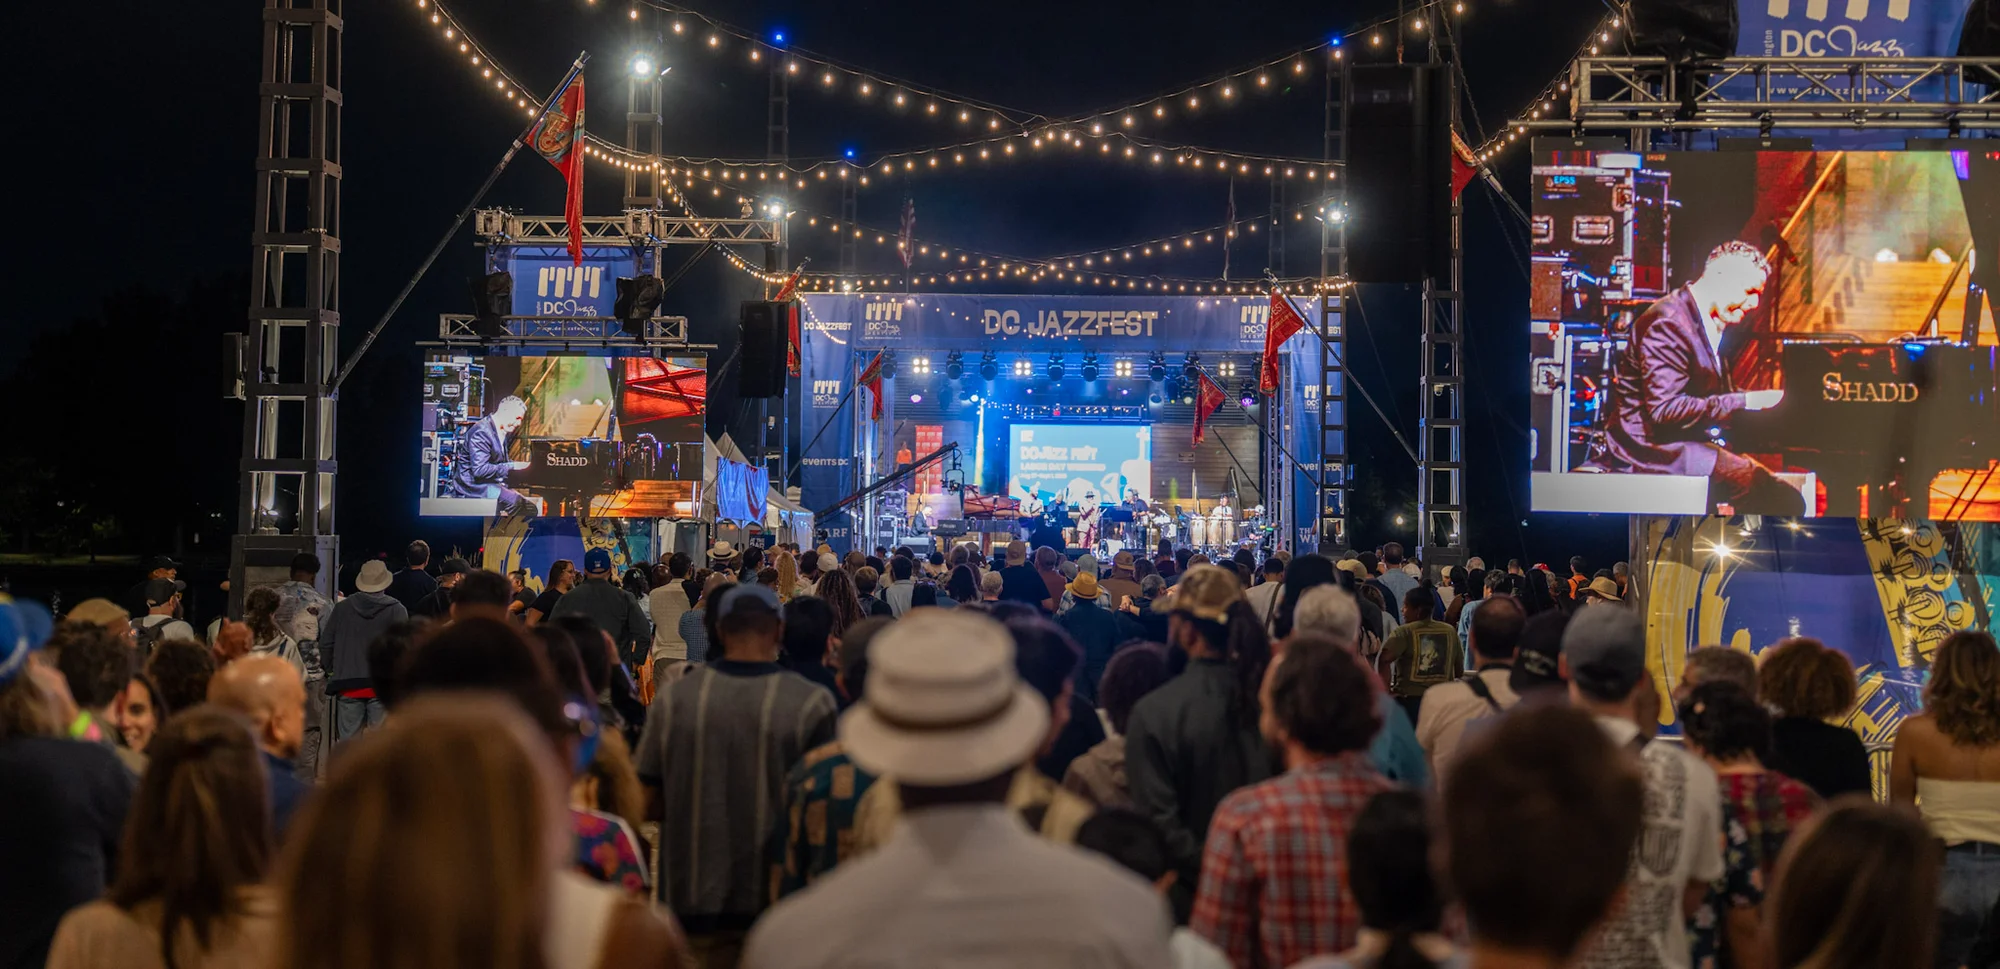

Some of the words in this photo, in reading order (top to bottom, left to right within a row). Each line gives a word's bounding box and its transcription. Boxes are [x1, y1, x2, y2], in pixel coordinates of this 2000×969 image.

[1780, 29, 1826, 58] DC
[543, 301, 564, 315] DC
[804, 322, 815, 331] DC
[815, 321, 853, 331] JAZZFEST
[868, 322, 881, 331] DC
[984, 309, 1021, 335] DC
[1027, 310, 1159, 337] JAZZFEST
[1244, 325, 1257, 334] DC
[1822, 371, 1920, 402] SHADD
[546, 452, 588, 467] SHADD
